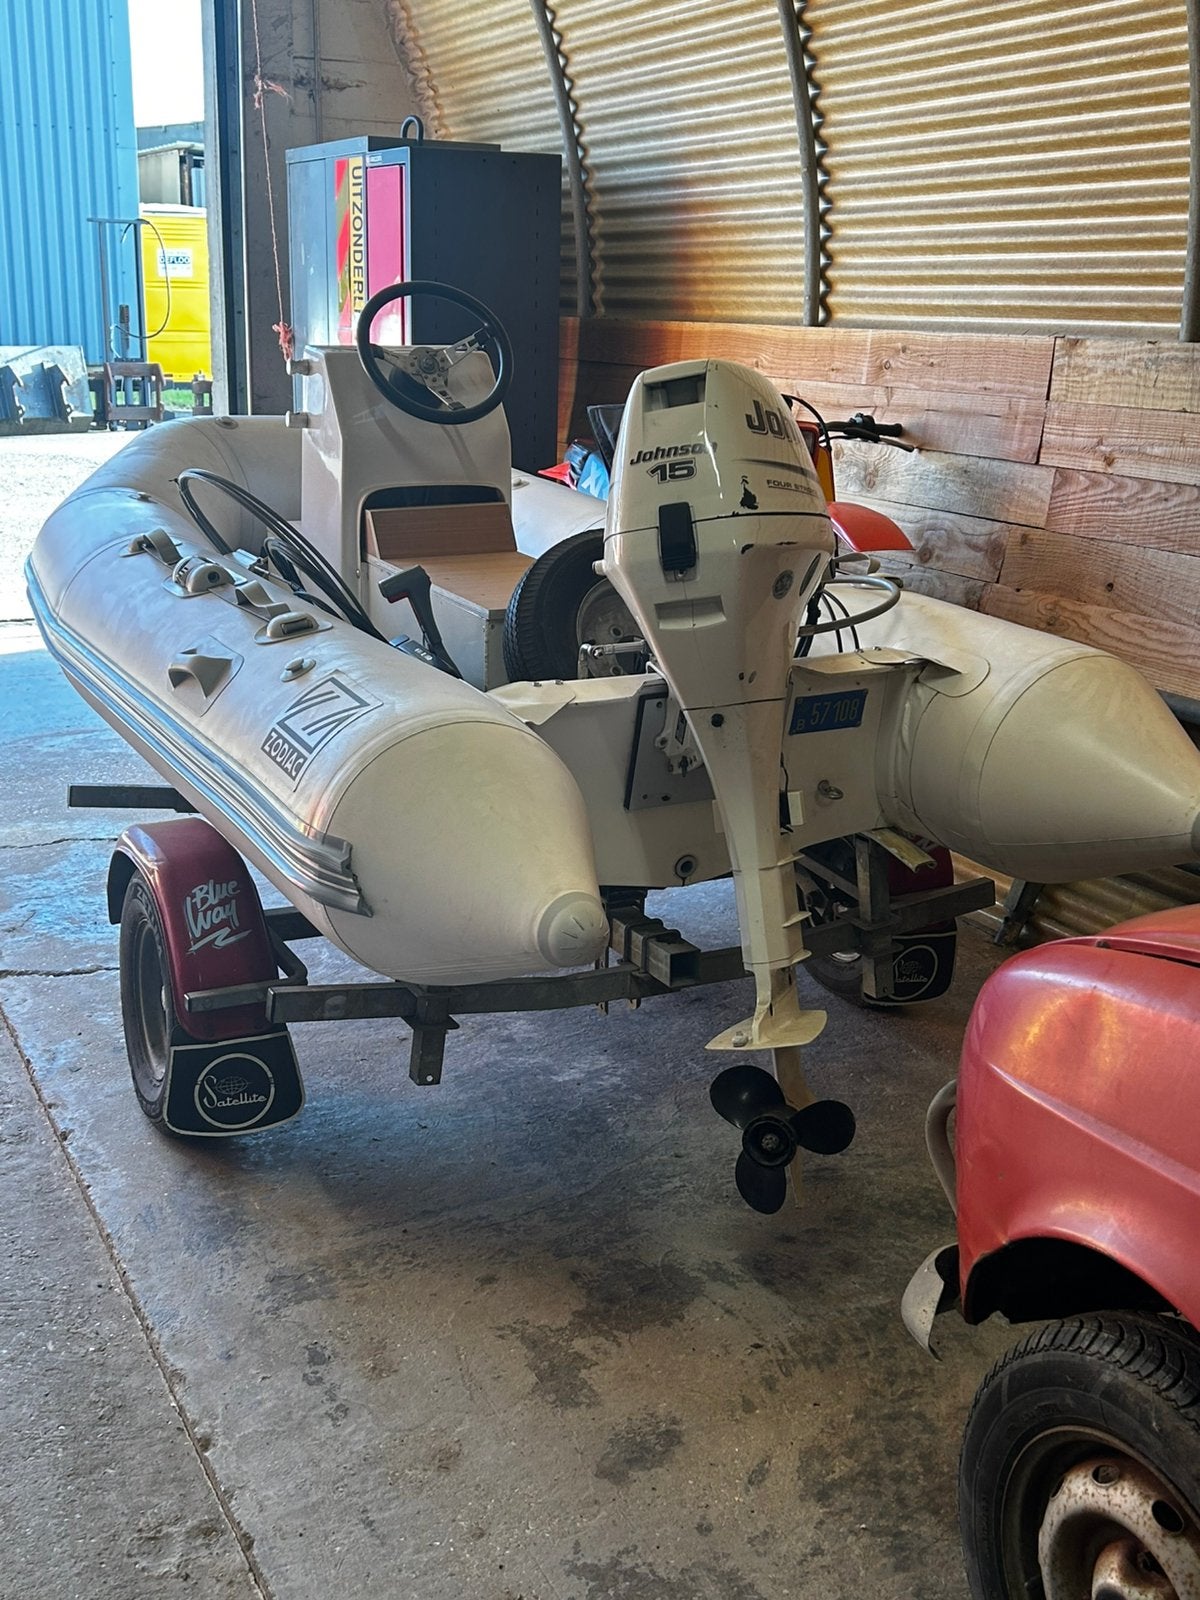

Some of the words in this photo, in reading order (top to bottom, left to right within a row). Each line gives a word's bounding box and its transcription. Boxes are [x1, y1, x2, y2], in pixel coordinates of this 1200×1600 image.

[629, 441, 718, 466] Johnson
[647, 457, 697, 484] 15
[766, 479, 792, 489] FOUR
[796, 718, 806, 731] B
[262, 730, 305, 778] ZODIAC
[192, 879, 241, 911] Blue
[184, 896, 240, 940] Way
[203, 1074, 268, 1110] Satellite
